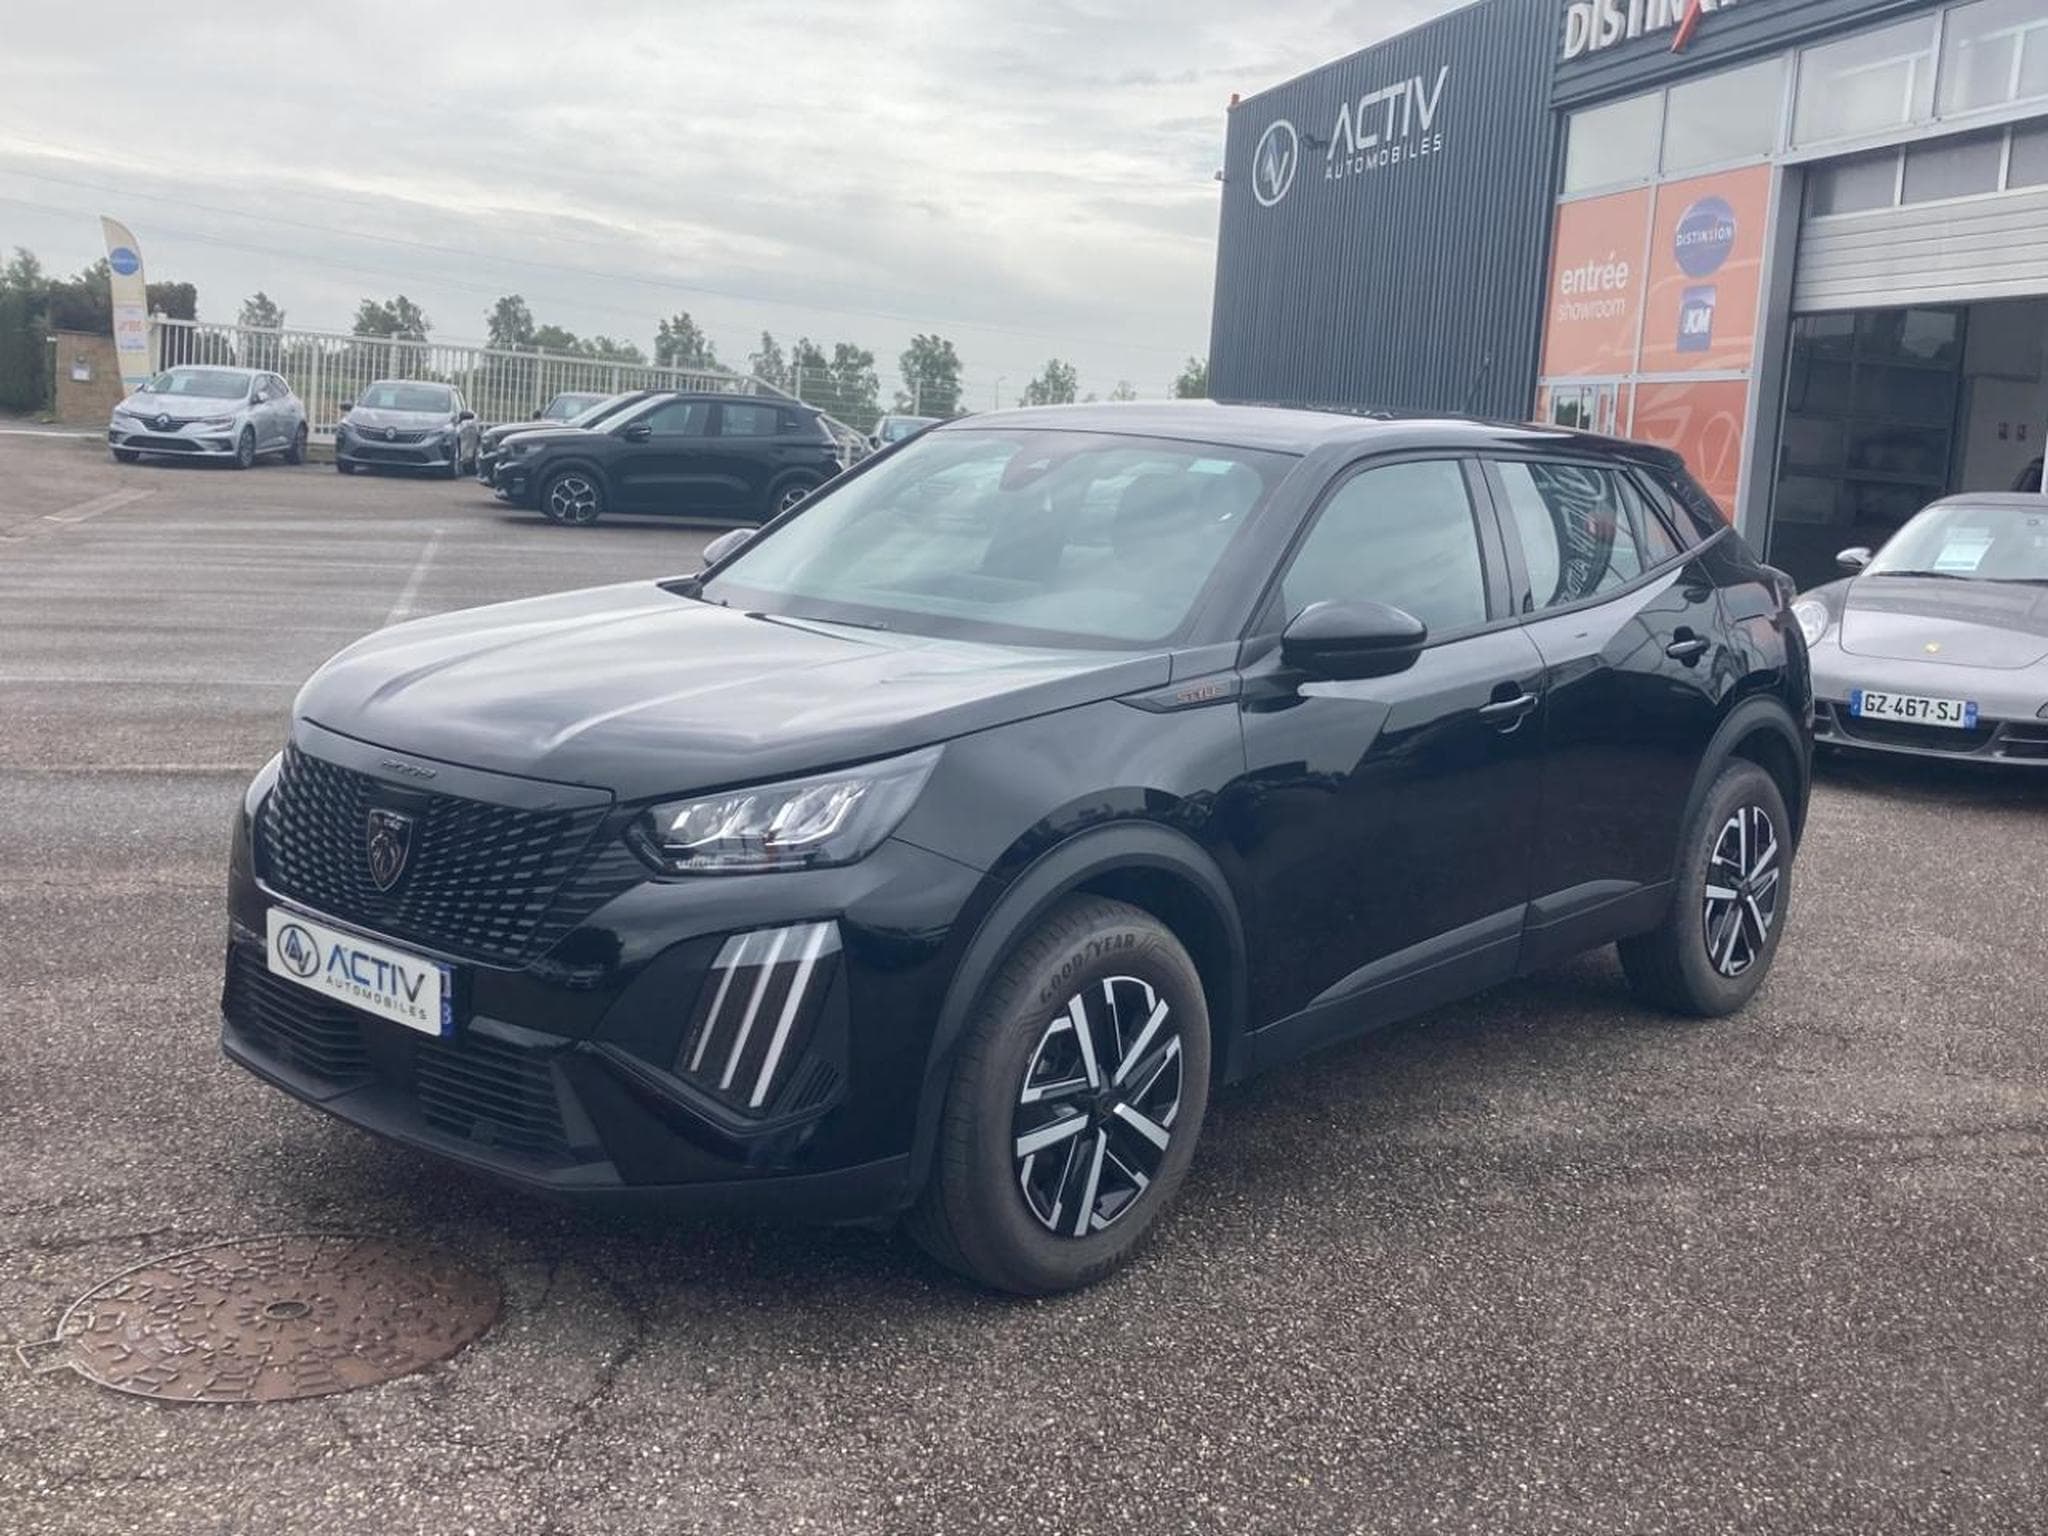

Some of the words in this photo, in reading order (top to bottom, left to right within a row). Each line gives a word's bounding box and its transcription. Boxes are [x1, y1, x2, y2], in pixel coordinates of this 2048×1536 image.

[1326, 65, 1449, 161] ACTIV
[1325, 134, 1441, 180] AUTOMOBILES
[1560, 250, 1629, 295] entrée
[1558, 297, 1626, 321] showroom
[1865, 693, 1962, 722] GZ-467-SJ
[326, 944, 426, 1003] ACTIV
[325, 976, 428, 1020] AUTOMOBILES
